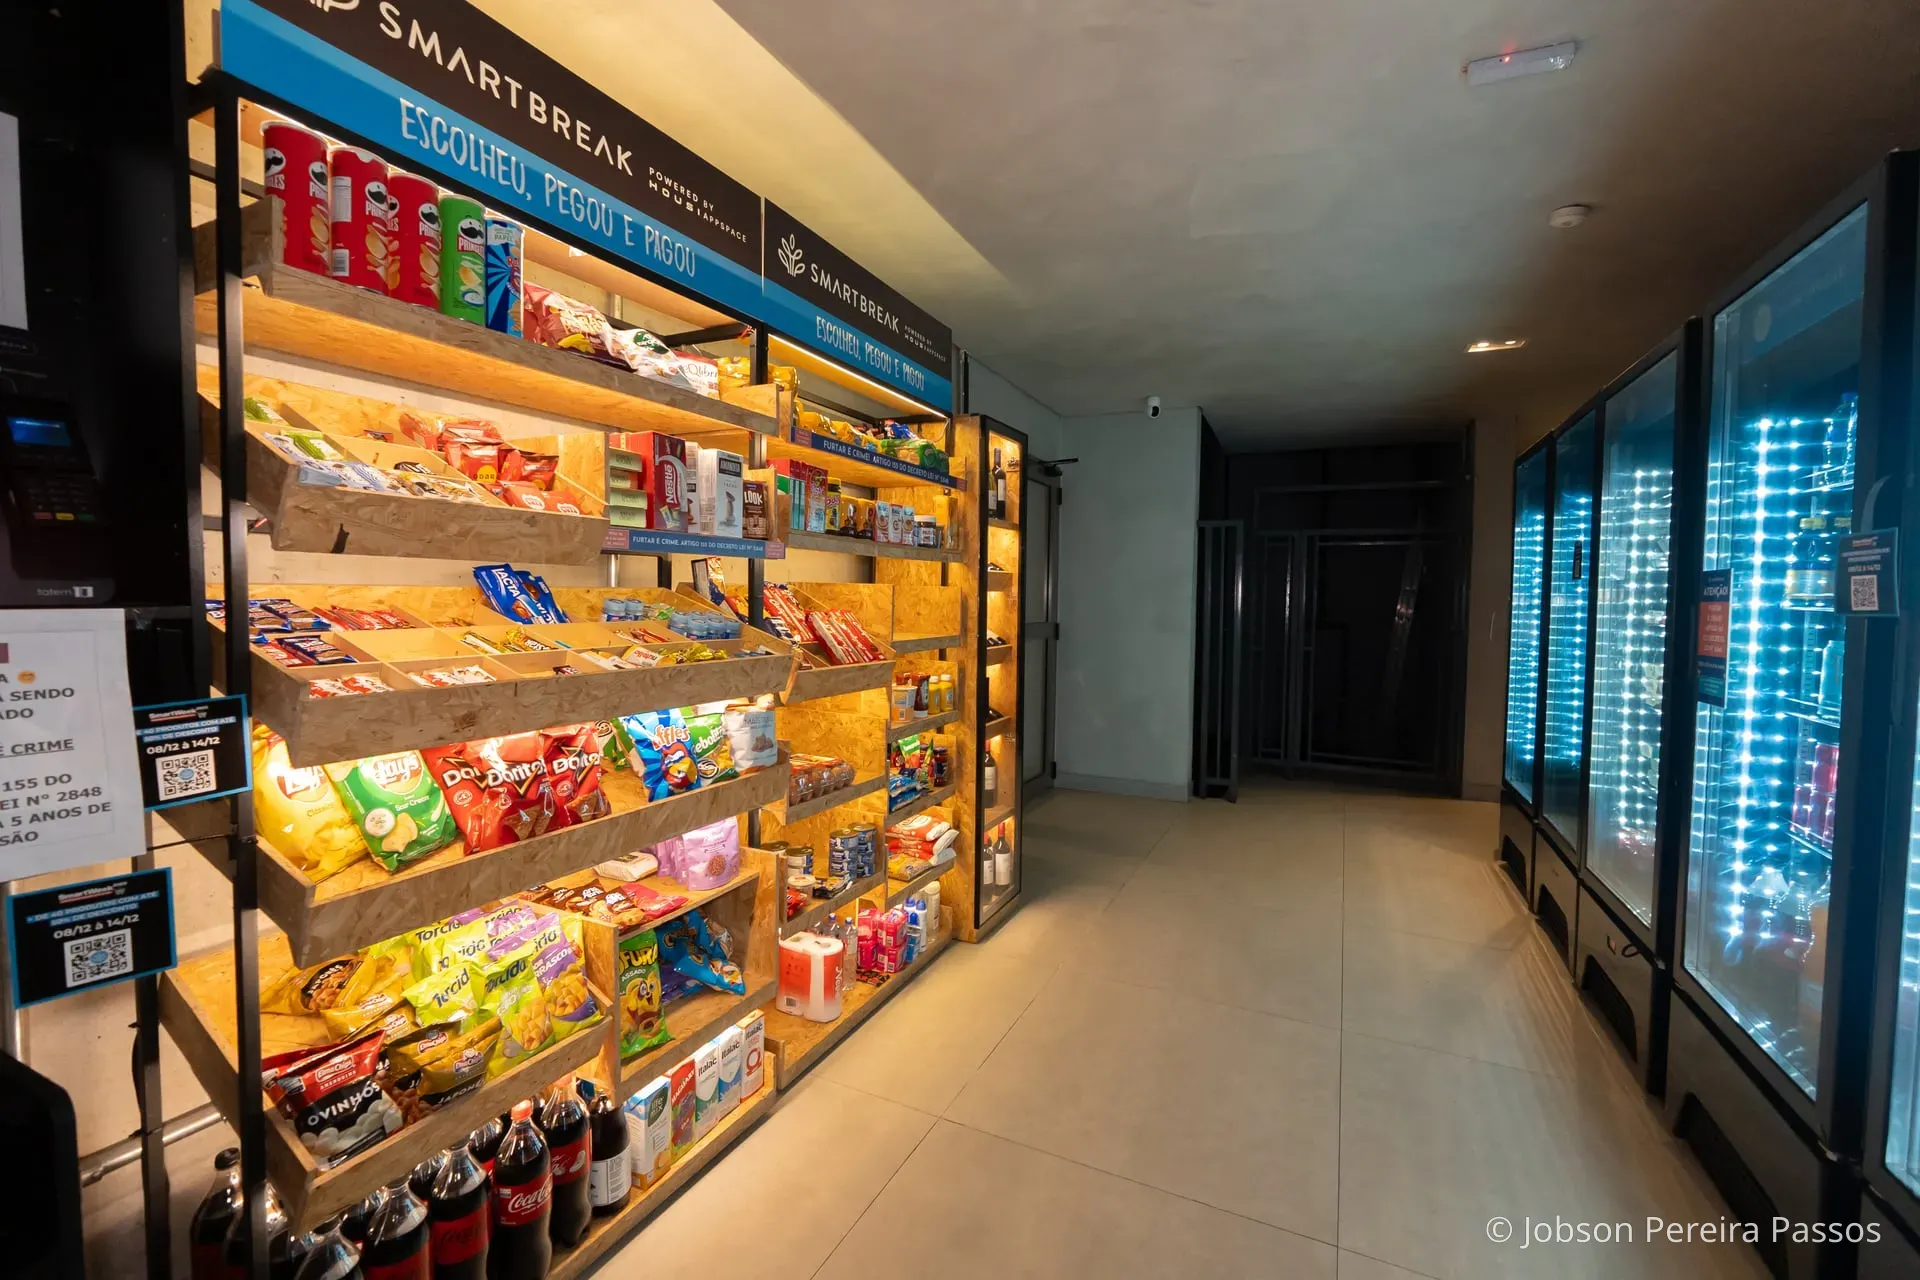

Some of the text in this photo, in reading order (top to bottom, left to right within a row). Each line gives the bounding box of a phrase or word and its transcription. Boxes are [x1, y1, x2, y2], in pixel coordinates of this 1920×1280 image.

[378, 1, 633, 177] SMARTBREAK
[400, 97, 696, 278] ESCOLHEU, PEGOU E PAGOU
[649, 166, 714, 212] POWERED BY
[703, 213, 747, 243] APPSPACE
[811, 263, 899, 334] SMARTBREAK
[816, 315, 925, 392] ESCOLHEU, PEGOU E PAGOU
[824, 440, 848, 455] FURTAR
[873, 456, 892, 469] ARTIGO
[899, 463, 906, 472] DO
[907, 464, 928, 478] DECRETO
[632, 536, 656, 545] FURTAR
[709, 541, 716, 549] DO
[716, 542, 738, 550] DECRETO
[491, 567, 520, 598] LACTA
[10, 687, 75, 701] SENDO
[11, 738, 74, 755] CRIME
[146, 743, 180, 755] 08/12
[191, 736, 221, 748] 14/12
[3, 773, 73, 792] 155 DO
[57, 786, 102, 802] 2848
[11, 801, 112, 827] 5 ANOS DE
[53, 924, 92, 939] 08/12
[107, 913, 140, 927] 14/12
